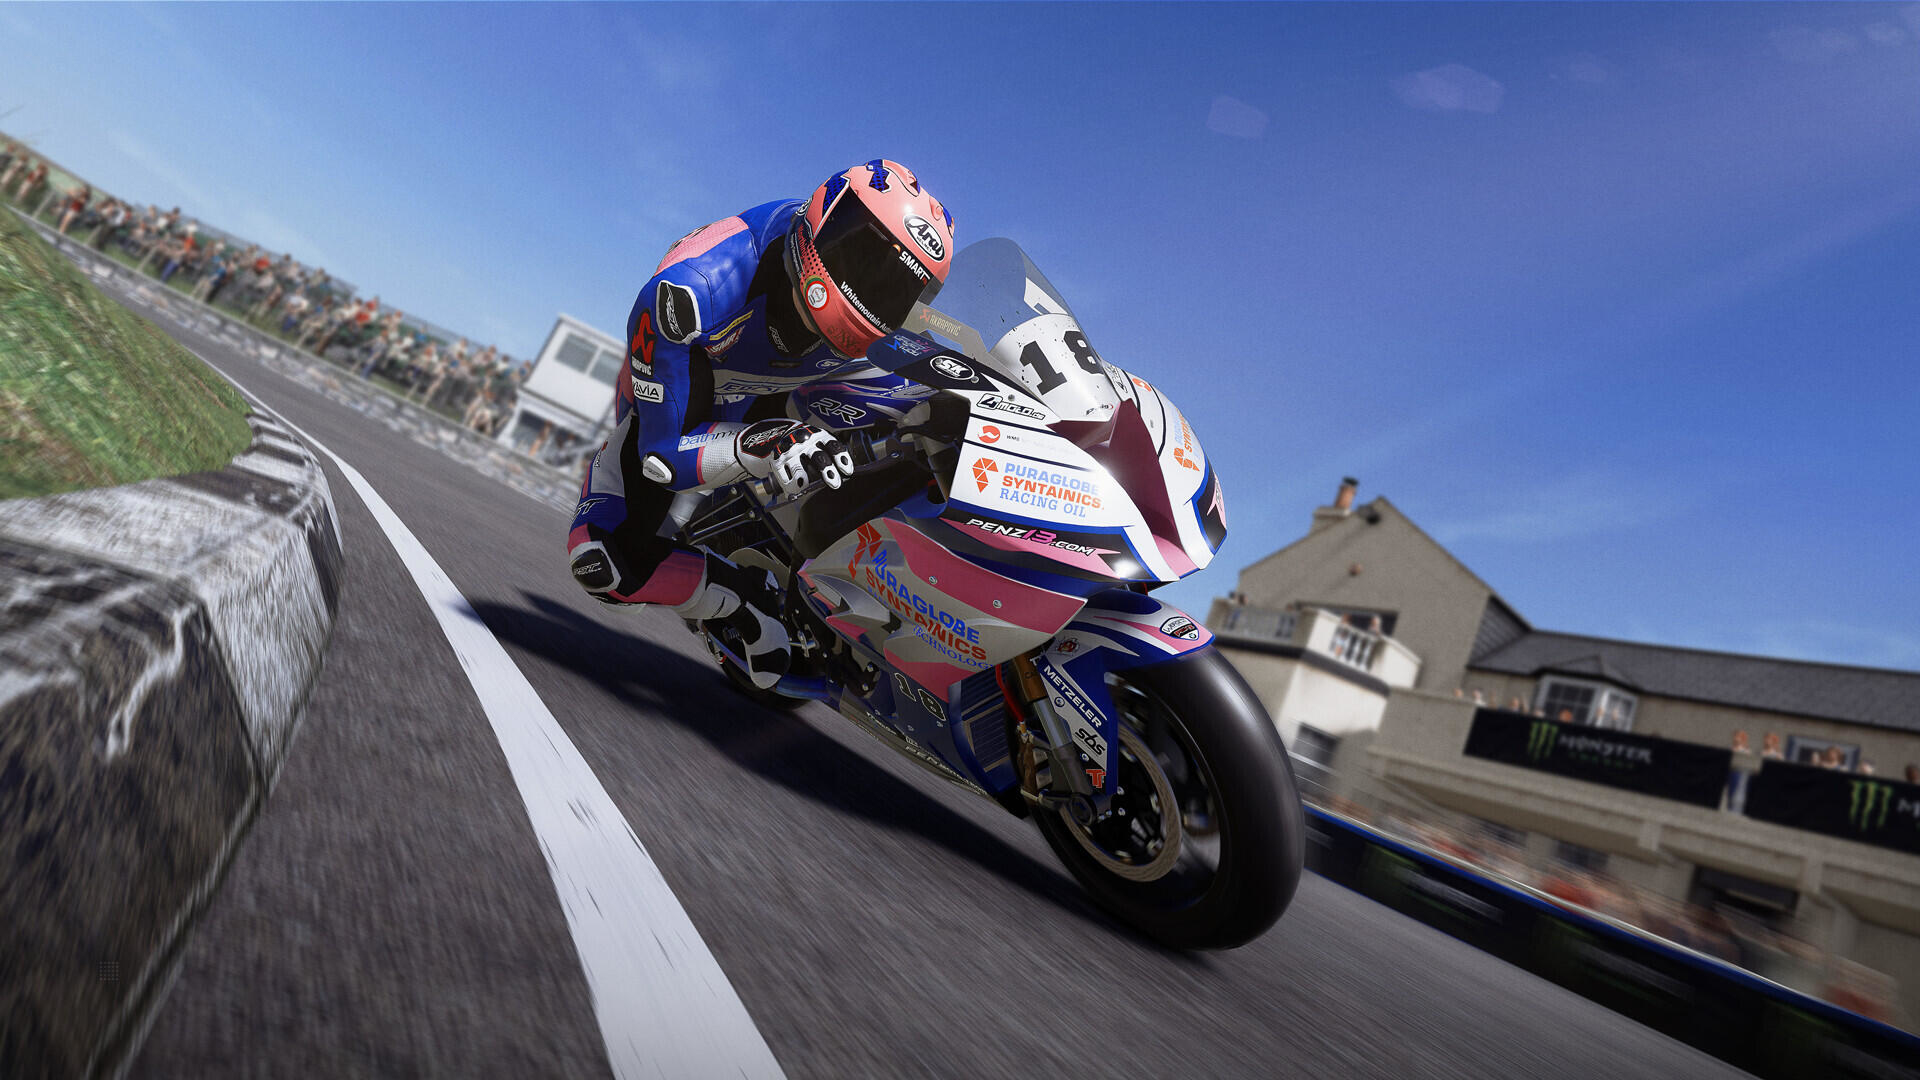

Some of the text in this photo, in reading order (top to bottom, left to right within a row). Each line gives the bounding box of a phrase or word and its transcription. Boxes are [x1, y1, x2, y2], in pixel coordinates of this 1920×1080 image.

[906, 223, 944, 255] Arai
[1018, 330, 1105, 396] 18
[810, 398, 867, 426] RR
[999, 487, 1086, 518] RACING OIL
[1004, 462, 1100, 497] PURAGLOBE
[865, 566, 987, 661] SYNTAINICS
[872, 549, 981, 645] PURAGLOBE
[912, 623, 994, 670] TECHNOLOG
[895, 672, 946, 721] 18
[1043, 664, 1102, 729] METZELER
